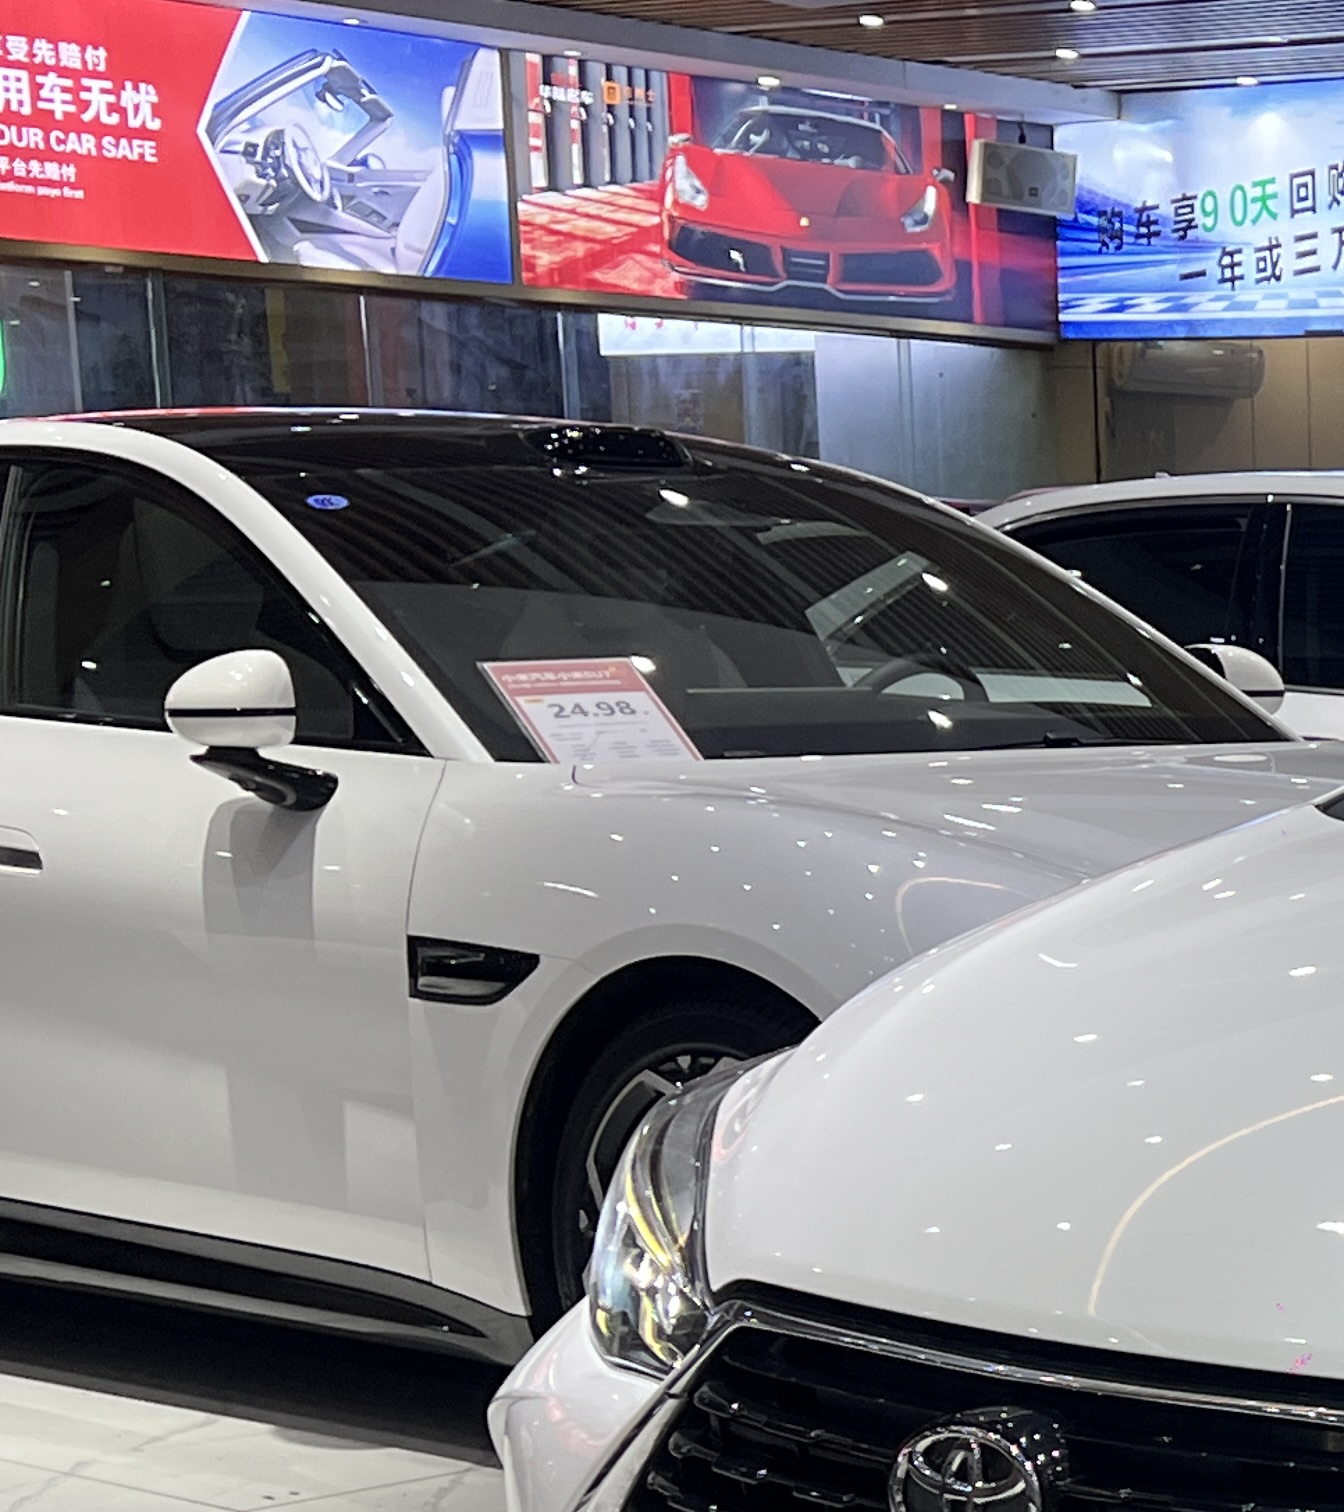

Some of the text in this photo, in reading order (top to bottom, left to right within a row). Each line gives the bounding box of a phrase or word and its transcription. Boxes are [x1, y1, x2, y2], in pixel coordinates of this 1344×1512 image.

[0, 33, 108, 73] 受先赔付
[49, 129, 98, 157] CAR
[101, 135, 159, 163] SAFE
[546, 700, 637, 719] 24.98
